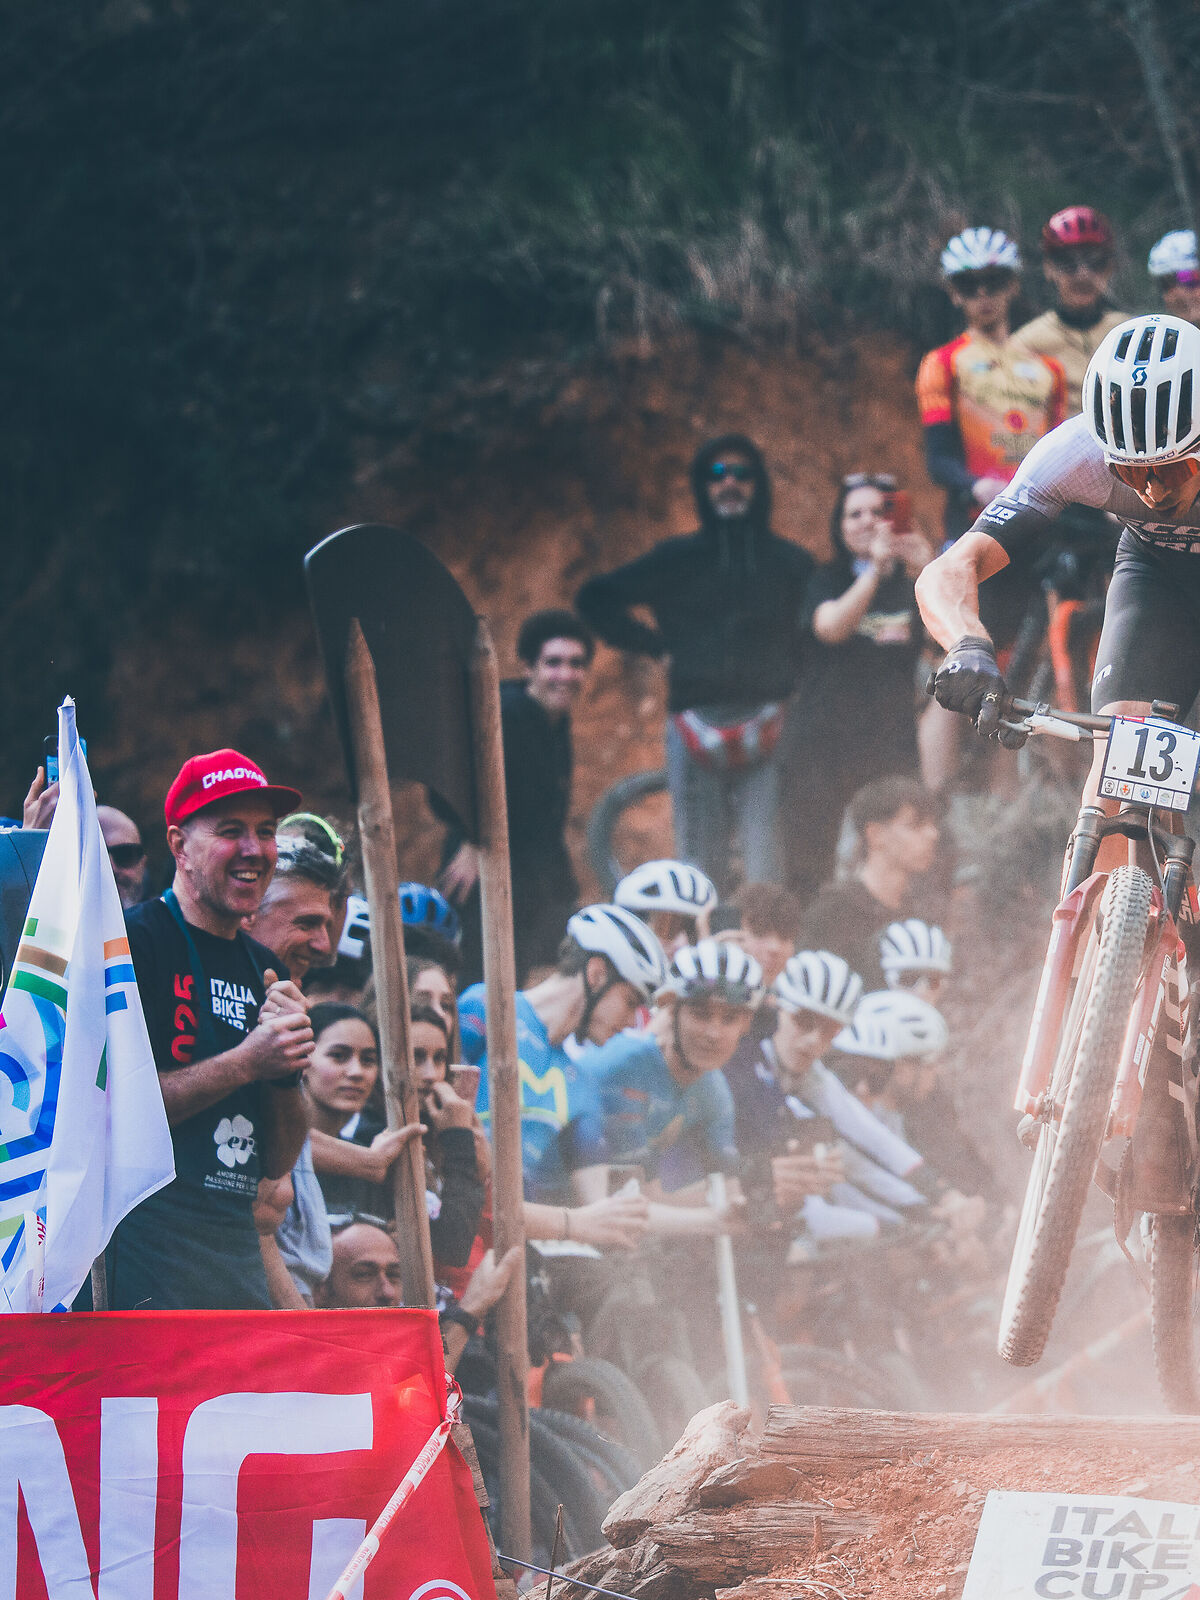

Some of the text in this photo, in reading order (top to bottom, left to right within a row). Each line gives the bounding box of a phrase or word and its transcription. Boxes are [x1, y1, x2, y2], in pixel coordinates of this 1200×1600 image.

[1127, 727, 1177, 782] 13
[210, 978, 257, 1007] ITALIA
[211, 996, 247, 1020] BIKE
[1041, 1536, 1193, 1570] BIKE
[1034, 1570, 1169, 1600] CUP
